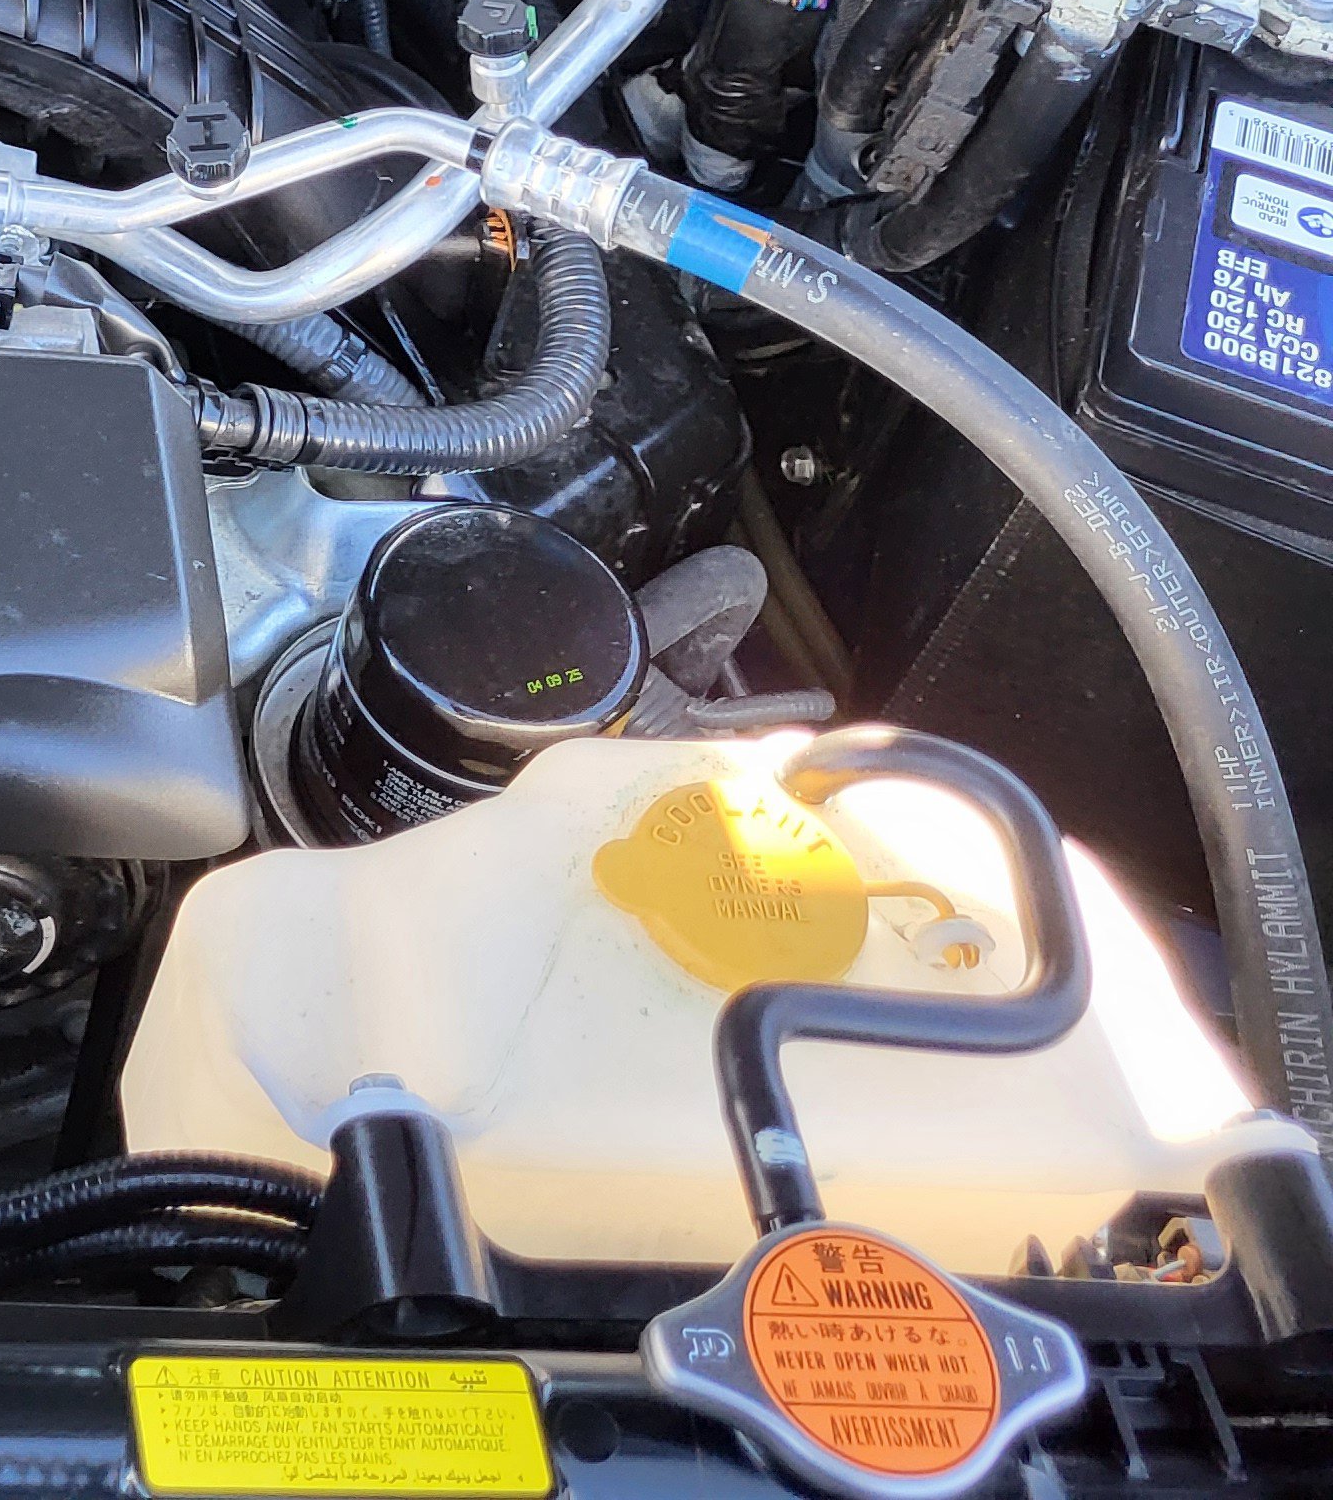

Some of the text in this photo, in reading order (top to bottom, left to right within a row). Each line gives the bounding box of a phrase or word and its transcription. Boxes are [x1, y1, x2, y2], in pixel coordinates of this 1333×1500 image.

[1258, 211, 1287, 228] READ
[1217, 249, 1268, 280] EFB
[1213, 268, 1292, 308] Ah 76
[1210, 292, 1305, 336] RC 120
[1207, 311, 1320, 363] CCA 750
[1204, 331, 1333, 389] 821B900
[527, 679, 543, 695] 04
[546, 673, 562, 688] 09
[718, 851, 766, 875] SEE
[714, 898, 811, 923] MANUAL
[821, 1278, 933, 1310] WARNING
[774, 1351, 826, 1371] NEVER
[834, 1352, 877, 1372] OPEN
[883, 1353, 931, 1373] WHEN
[240, 1368, 430, 1389] CAUTION ATTENTION
[781, 1379, 799, 1399] NE
[811, 1380, 856, 1400] JAMAIS
[866, 1381, 908, 1401] OUVRIR
[175, 1419, 209, 1433] KEEP
[215, 1419, 262, 1433] HANDS
[312, 1421, 337, 1434] FAN
[343, 1422, 393, 1436] STARTS
[830, 1415, 961, 1449] AVERTISSMENT
[177, 1434, 191, 1448] LE
[195, 1432, 269, 1449] DÉMARRAGE
[273, 1435, 291, 1449] DU
[294, 1435, 374, 1450] VENTILATEUR
[196, 1450, 213, 1463] EN
[217, 1451, 292, 1465] APPROCHEZ
[295, 1451, 319, 1465] PAS
[323, 1452, 347, 1465] LES
